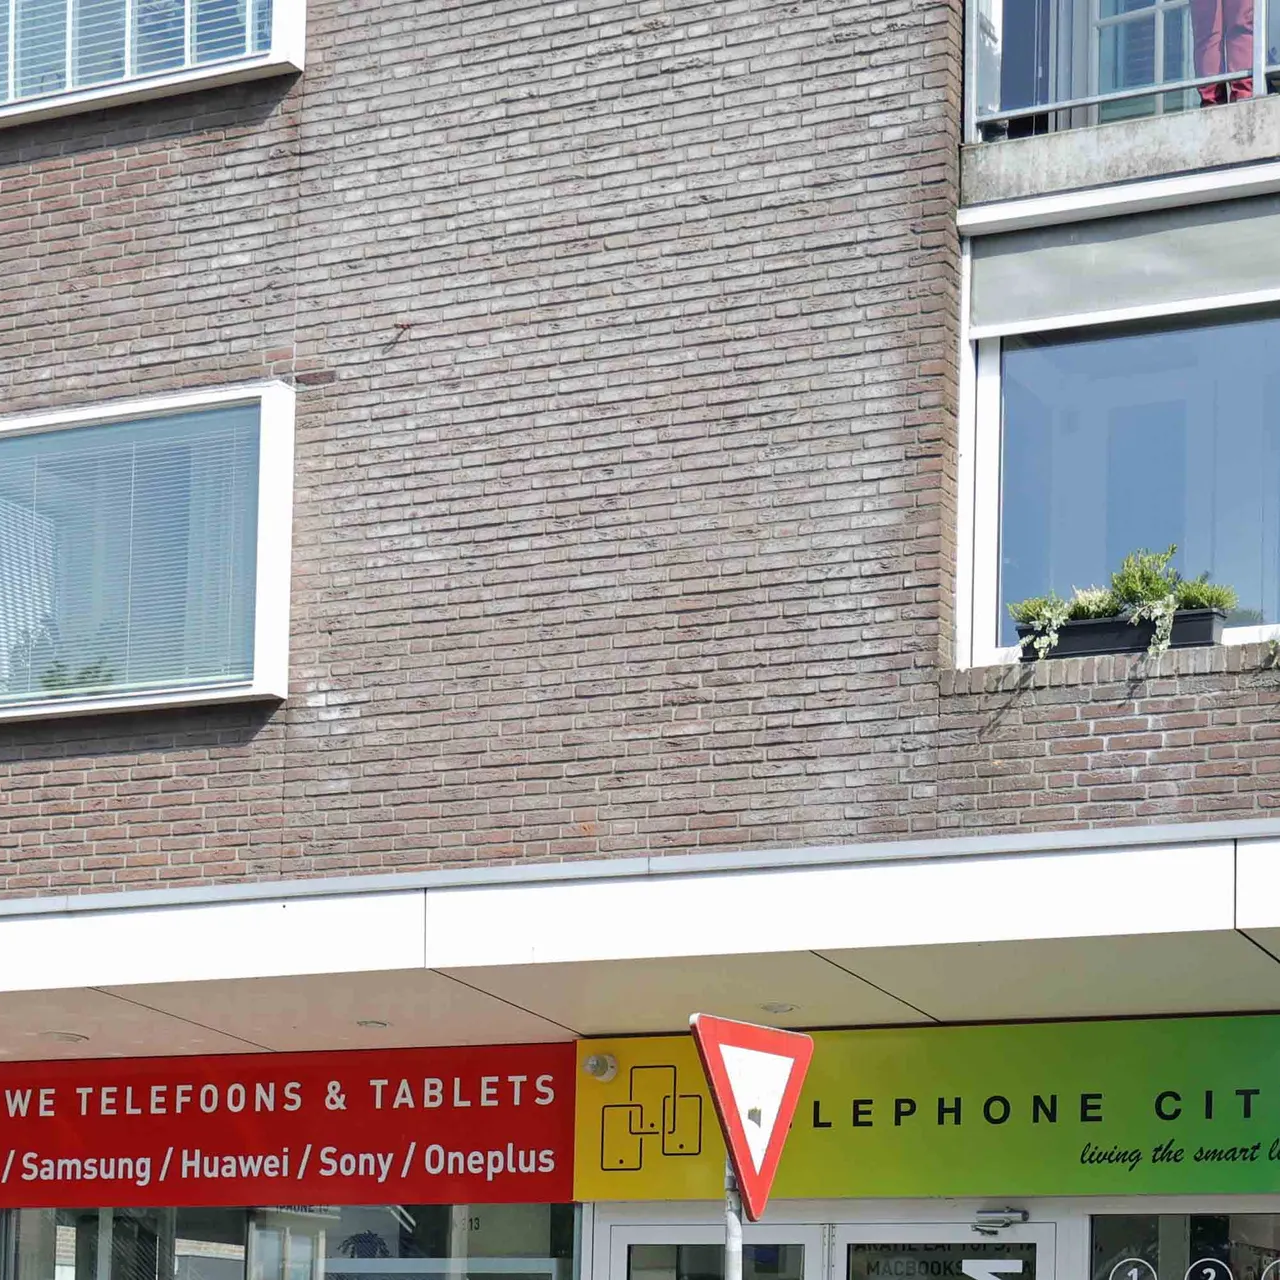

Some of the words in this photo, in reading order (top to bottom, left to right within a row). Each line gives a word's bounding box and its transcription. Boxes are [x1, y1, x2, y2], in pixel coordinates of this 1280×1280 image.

[76, 1081, 302, 1117] TELEFOONS
[324, 1080, 348, 1111] &
[370, 1074, 555, 1110] TABLETS
[812, 1093, 1103, 1128] LEPHONE
[1, 1149, 16, 1184] /
[21, 1151, 152, 1187] Samsung
[158, 1146, 174, 1182] /
[181, 1147, 289, 1179] Huawei
[296, 1143, 312, 1180] /
[319, 1146, 394, 1183] Sony
[400, 1141, 416, 1178] /
[424, 1142, 555, 1182] Oneplus
[1080, 1142, 1143, 1172] living
[1151, 1138, 1185, 1164] the
[1193, 1141, 1261, 1163] smart
[865, 1260, 962, 1277] MACBOOKS
